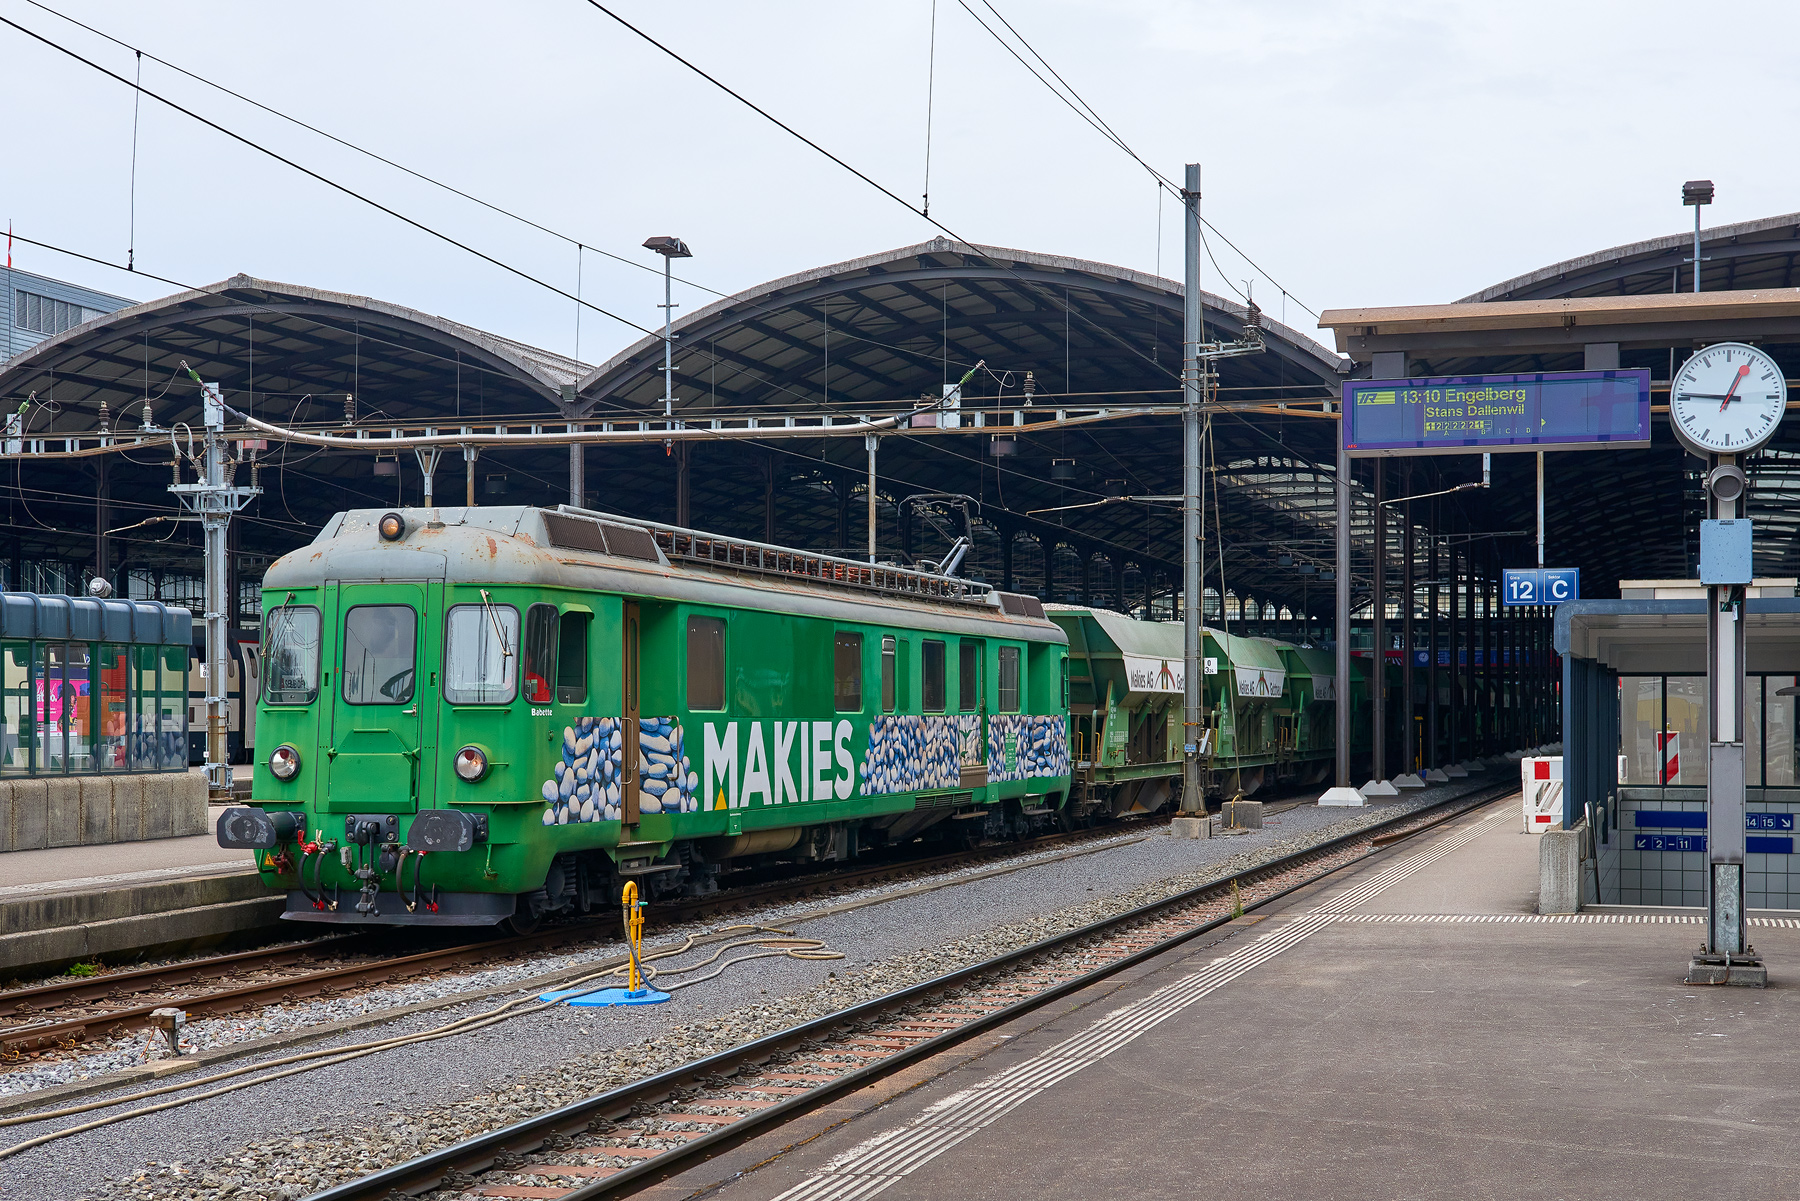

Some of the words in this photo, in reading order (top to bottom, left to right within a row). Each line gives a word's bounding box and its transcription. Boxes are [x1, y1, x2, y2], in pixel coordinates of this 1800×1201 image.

[1400, 390, 1441, 404] 13:10
[1445, 387, 1526, 405] Engelberg
[1426, 407, 1463, 418] Stans
[1467, 403, 1525, 416] Dallenwil
[1510, 581, 1533, 599] 12
[1552, 580, 1568, 598] C
[531, 708, 553, 716] Babette
[703, 719, 855, 812] MAKIES
[1746, 818, 1756, 827] 14
[1763, 818, 1774, 827] 15
[1656, 839, 1663, 848] 2
[1679, 840, 1688, 849] 11
